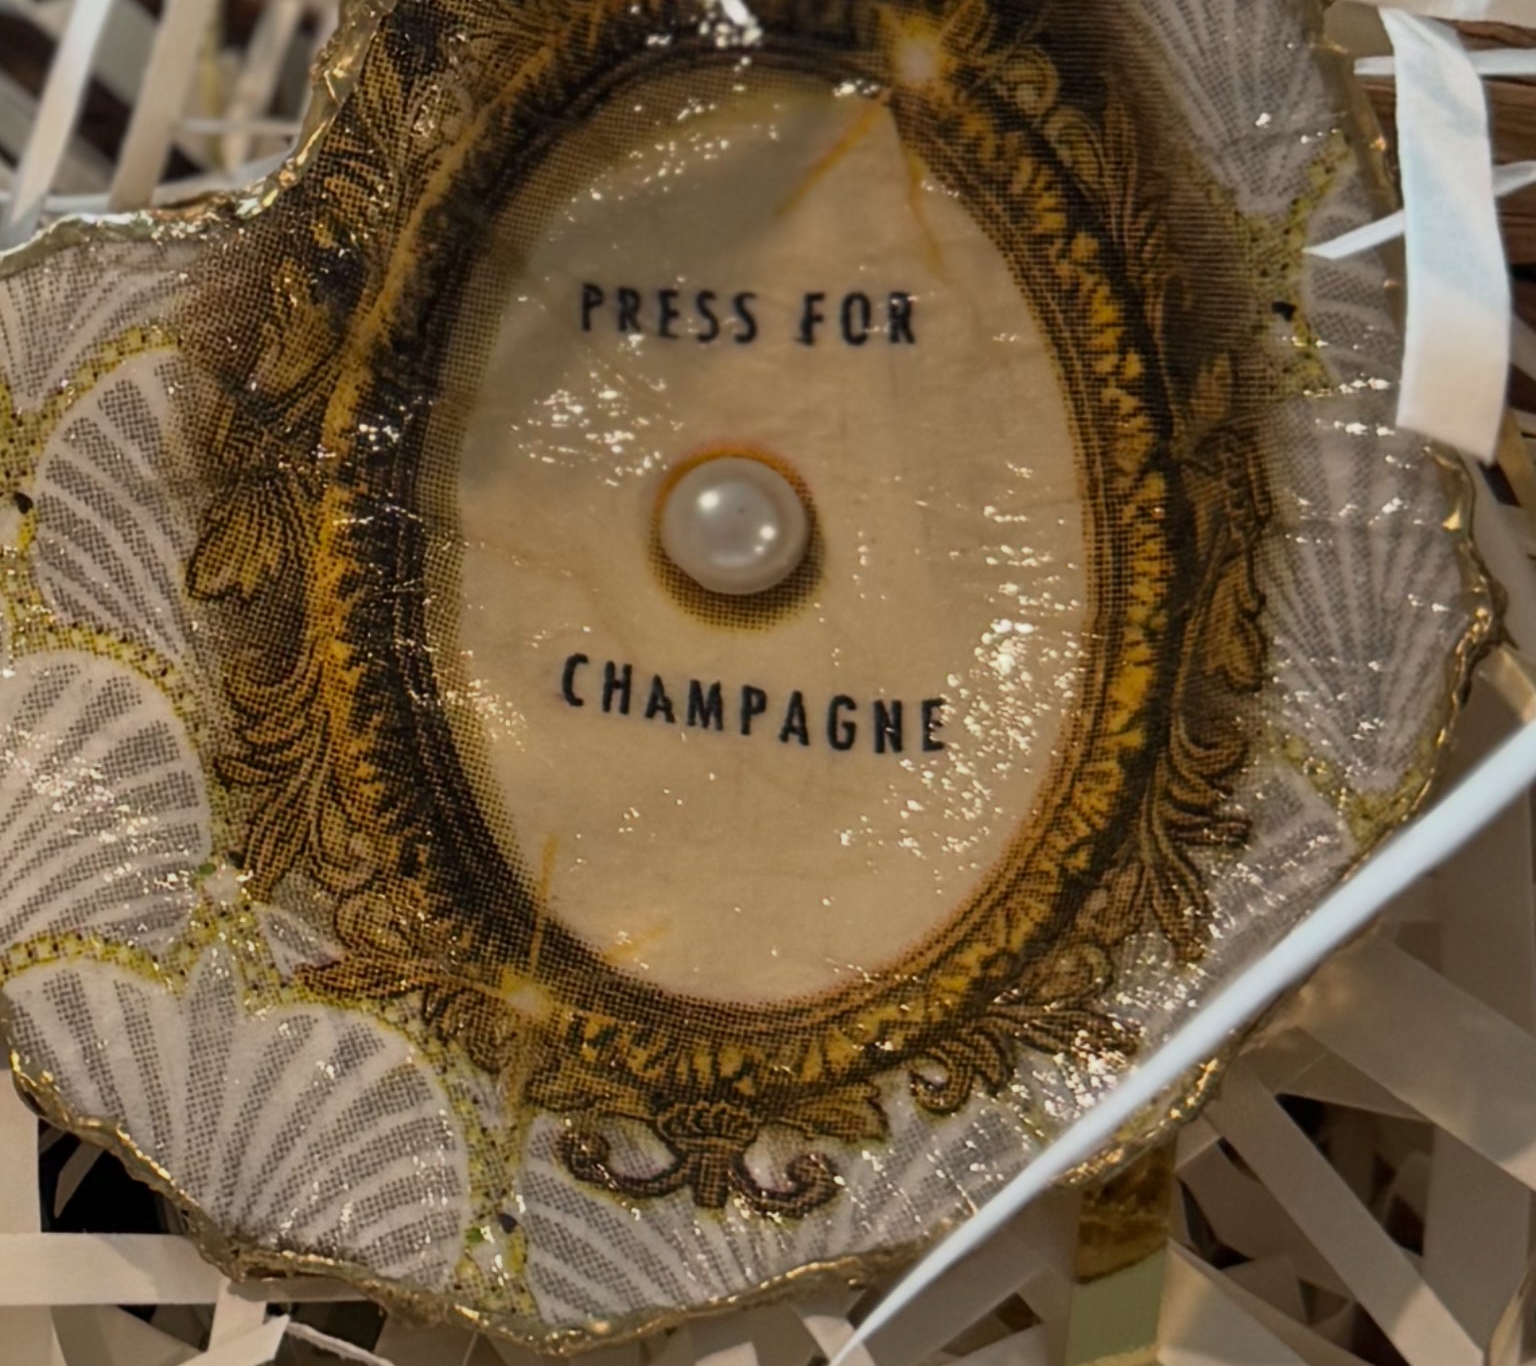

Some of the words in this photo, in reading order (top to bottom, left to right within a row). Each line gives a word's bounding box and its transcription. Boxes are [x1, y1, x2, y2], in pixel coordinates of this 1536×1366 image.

[580, 282, 758, 344] PRESS
[796, 290, 917, 346] FOR
[560, 652, 947, 755] CHAMPAGNE
